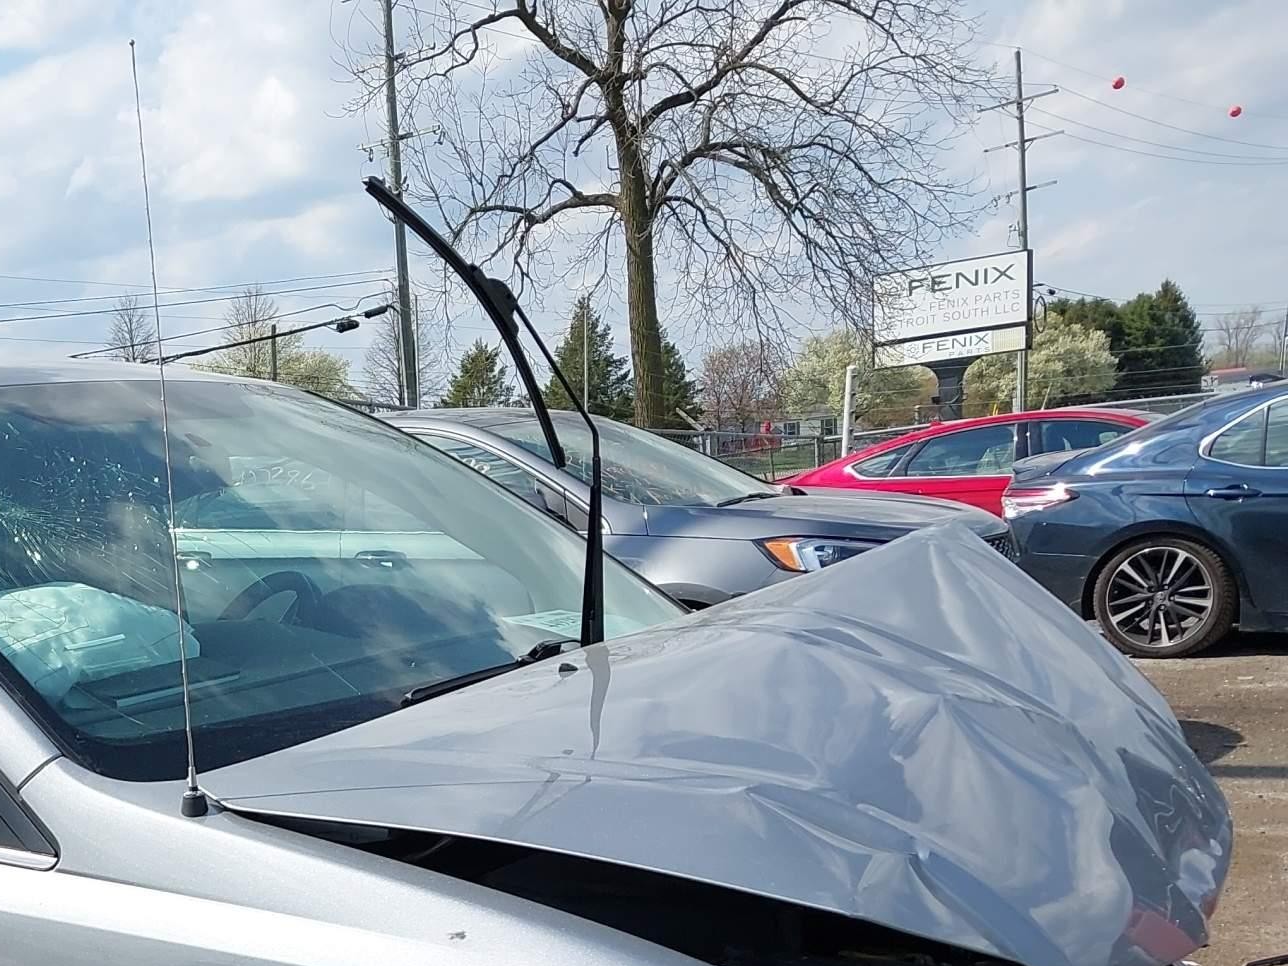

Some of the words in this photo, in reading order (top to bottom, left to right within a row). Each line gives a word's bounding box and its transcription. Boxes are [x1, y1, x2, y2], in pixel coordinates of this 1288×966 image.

[908, 263, 1016, 296] FENIX
[929, 296, 969, 312] FENIX
[974, 289, 1020, 305] PARTS
[943, 306, 989, 323] SOUTH
[994, 302, 1020, 316] LLC
[921, 333, 990, 354] FENIX
[948, 347, 991, 358] PARTS
